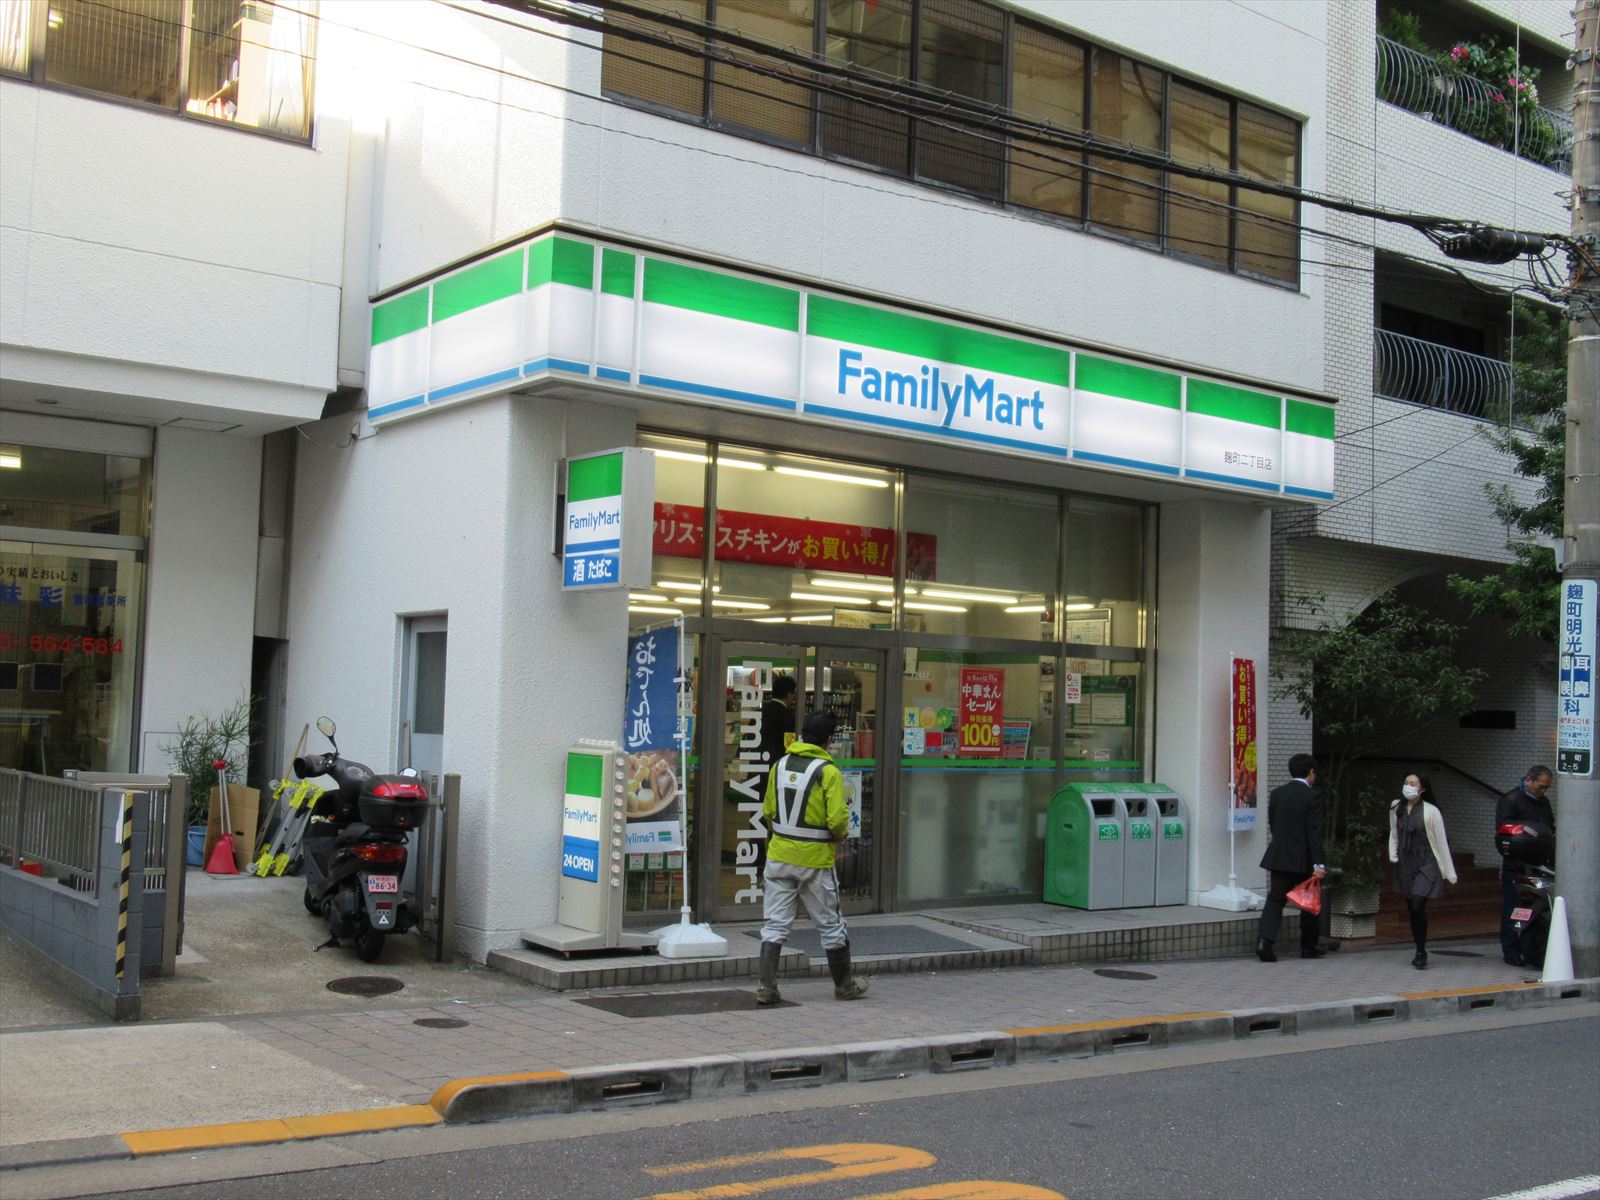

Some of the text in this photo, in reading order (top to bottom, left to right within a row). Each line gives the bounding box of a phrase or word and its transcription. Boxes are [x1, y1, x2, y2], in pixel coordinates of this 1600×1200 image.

[838, 348, 1044, 430] FamilyMart
[569, 510, 620, 530] FamilyMart
[653, 519, 889, 568] リススチキンがお買い得!
[573, 558, 612, 582] 酒 たばこ
[962, 683, 1002, 699] 中華まん
[966, 698, 997, 712] セール
[1564, 699, 1580, 716] 科
[961, 723, 992, 747] 100
[730, 661, 773, 905] FamilyMart
[564, 808, 598, 823] FamilyMart
[376, 882, 395, 890] 86-34
